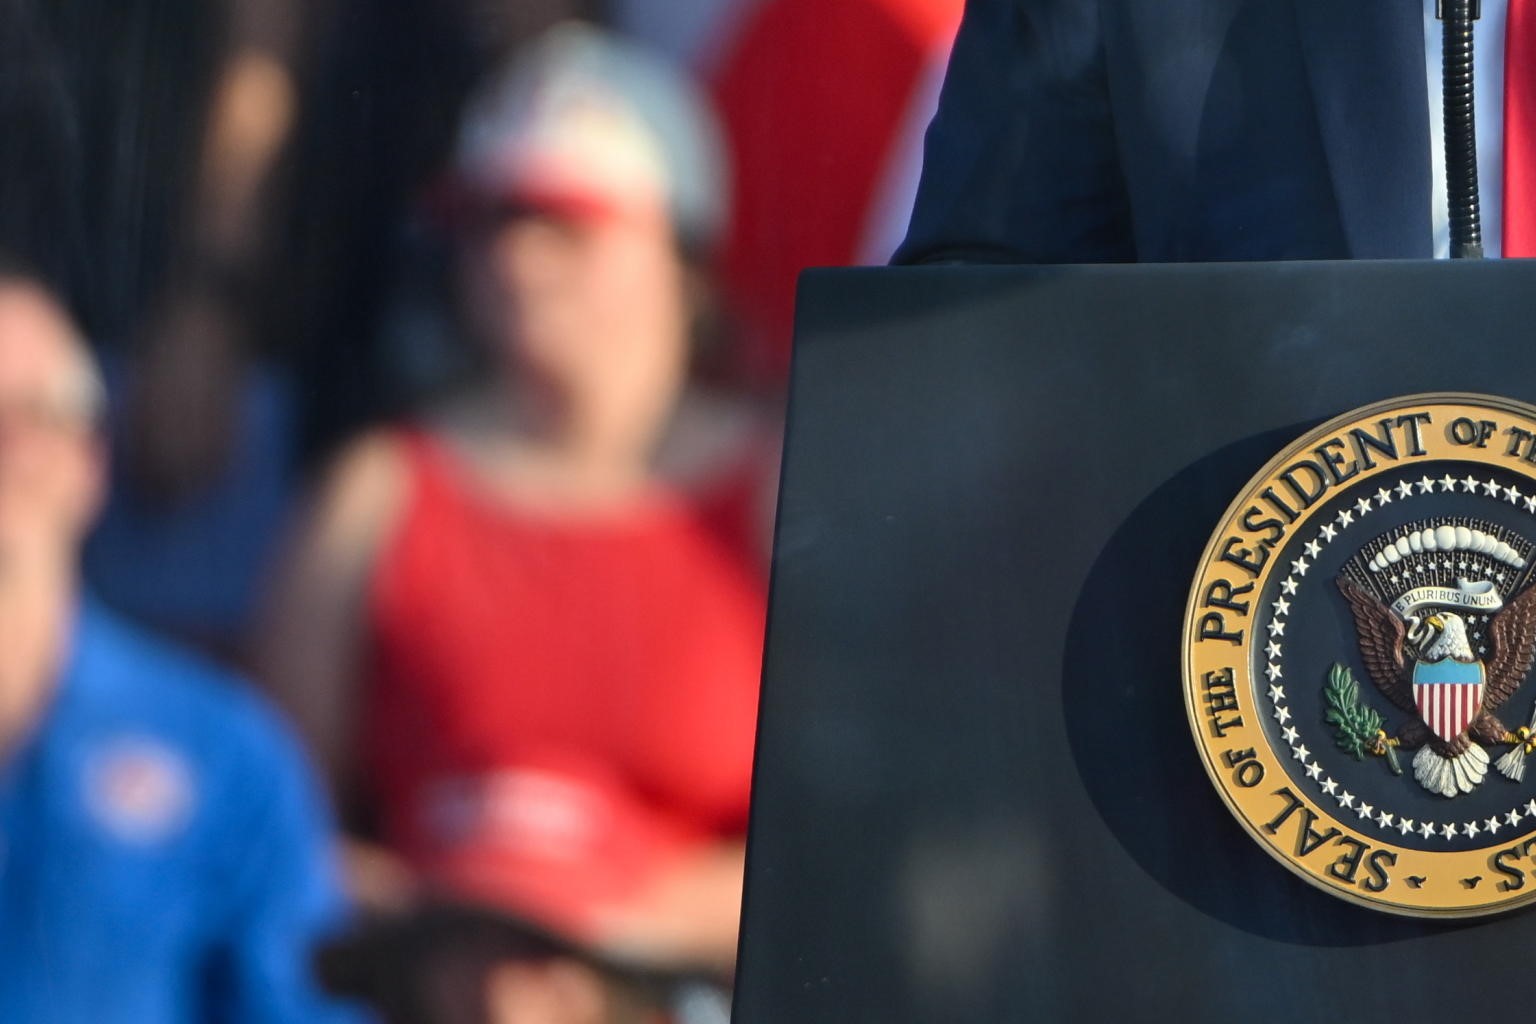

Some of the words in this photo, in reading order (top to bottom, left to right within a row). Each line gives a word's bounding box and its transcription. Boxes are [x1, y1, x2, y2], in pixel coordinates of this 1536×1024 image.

[1452, 417, 1497, 448] OF
[1202, 412, 1431, 646] PRESIDENT
[1395, 602, 1404, 612] E
[1404, 590, 1460, 605] PLURIBUS
[1463, 593, 1497, 606] UNUM
[1206, 668, 1239, 736] THE
[1227, 747, 1265, 788] OF
[1267, 787, 1398, 892] SEAL
